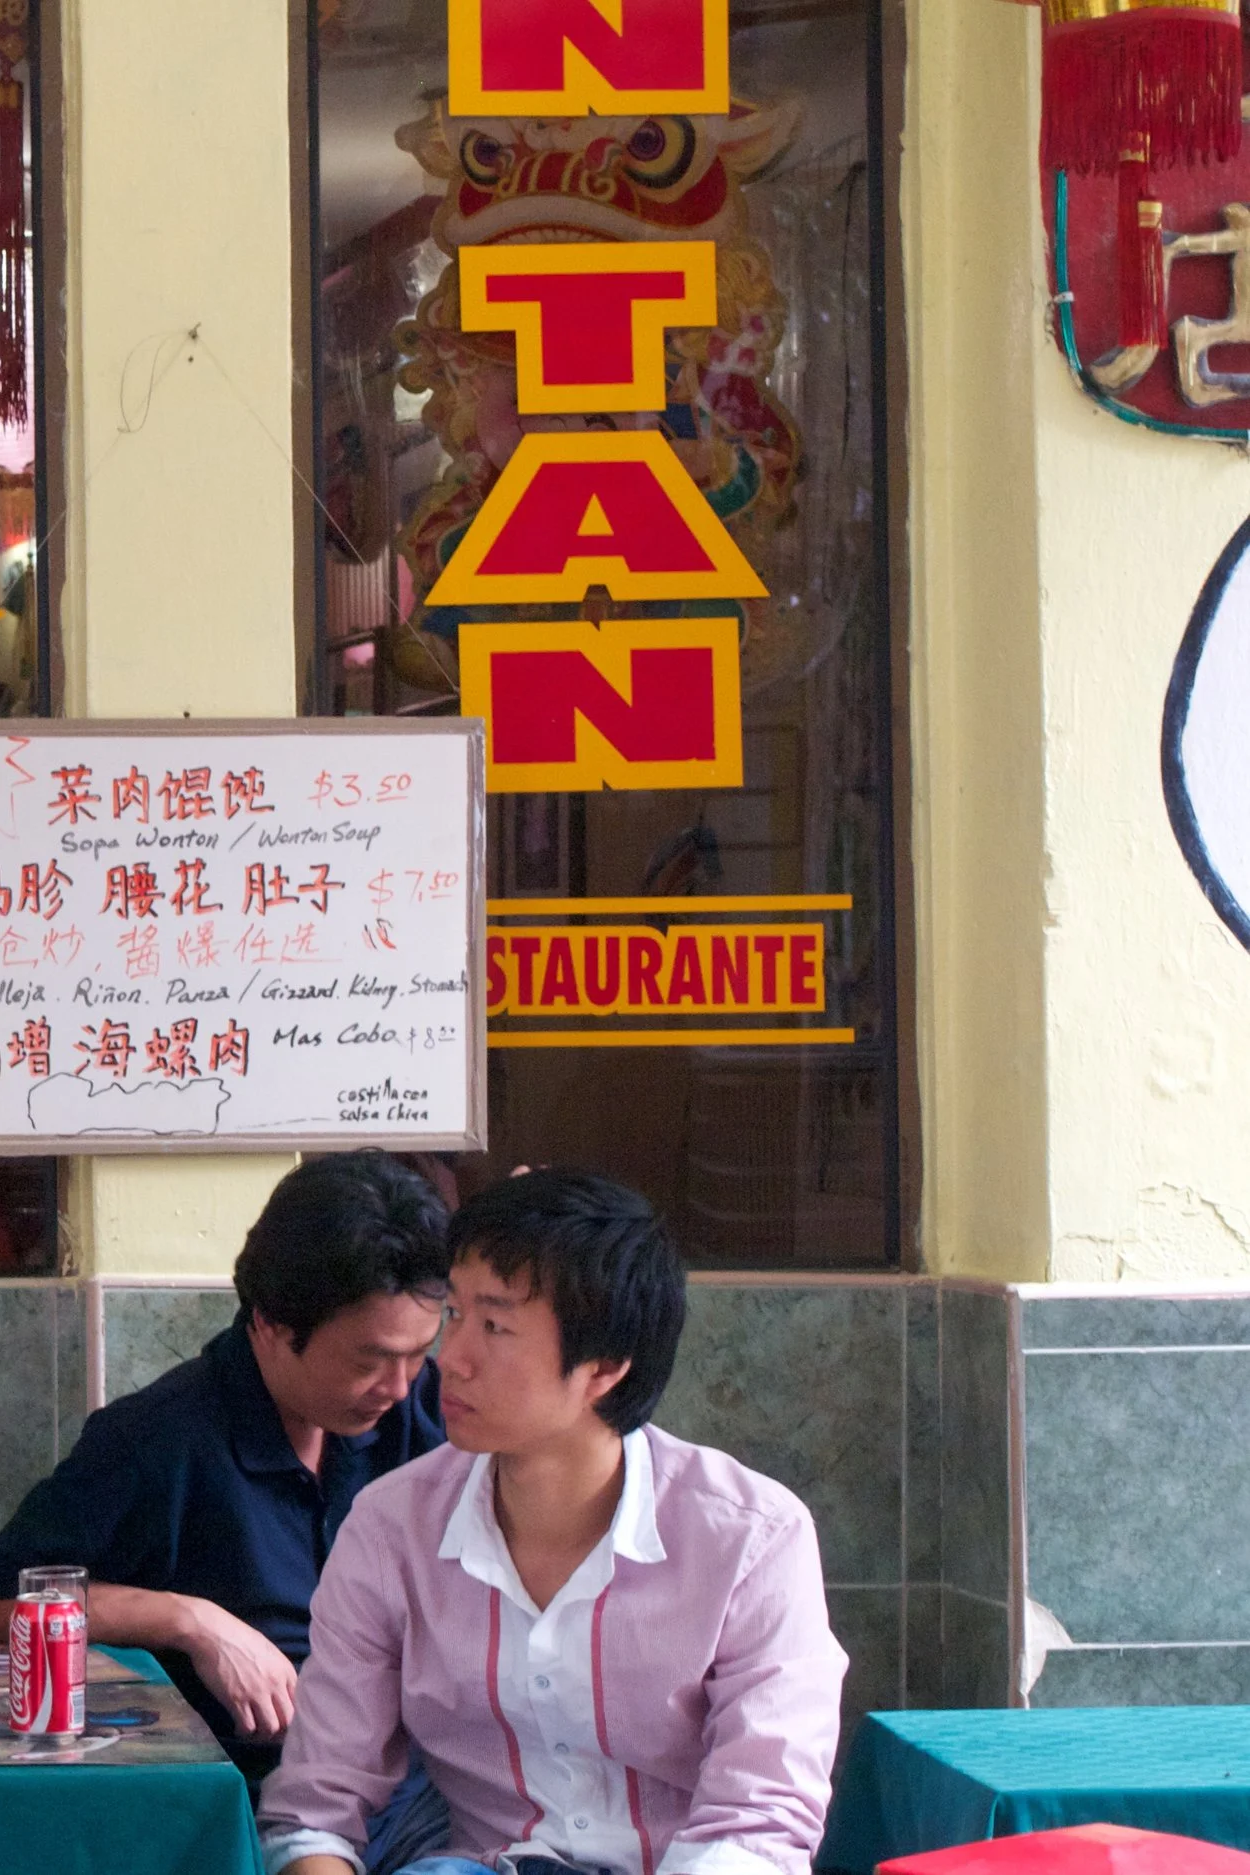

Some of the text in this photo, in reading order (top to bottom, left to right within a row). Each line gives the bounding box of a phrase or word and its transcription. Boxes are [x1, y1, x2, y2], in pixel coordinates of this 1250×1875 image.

[308, 769, 412, 809] $3.50
[60, 831, 120, 859] Sopa
[135, 827, 220, 851] Wonton
[165, 978, 231, 1005] Panza
[272, 1024, 323, 1048] Mas
[339, 1105, 379, 1122] salsa
